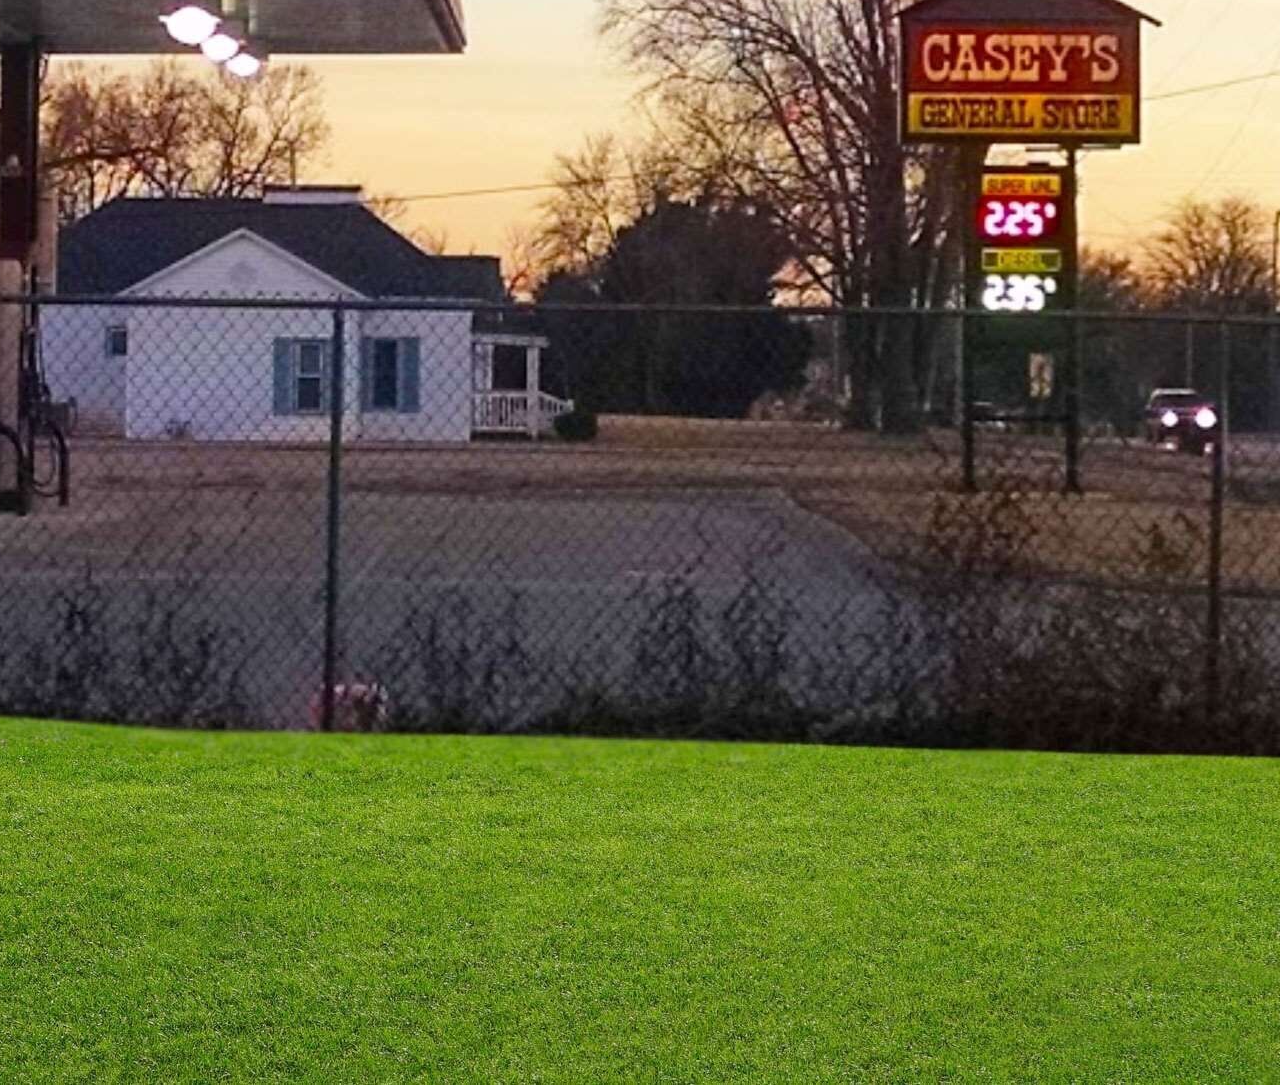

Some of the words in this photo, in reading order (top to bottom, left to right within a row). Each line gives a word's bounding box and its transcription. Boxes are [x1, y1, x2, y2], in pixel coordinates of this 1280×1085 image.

[922, 33, 1120, 83] CASEY'S
[921, 97, 1035, 129] GENERAL
[1041, 98, 1120, 129] STORE
